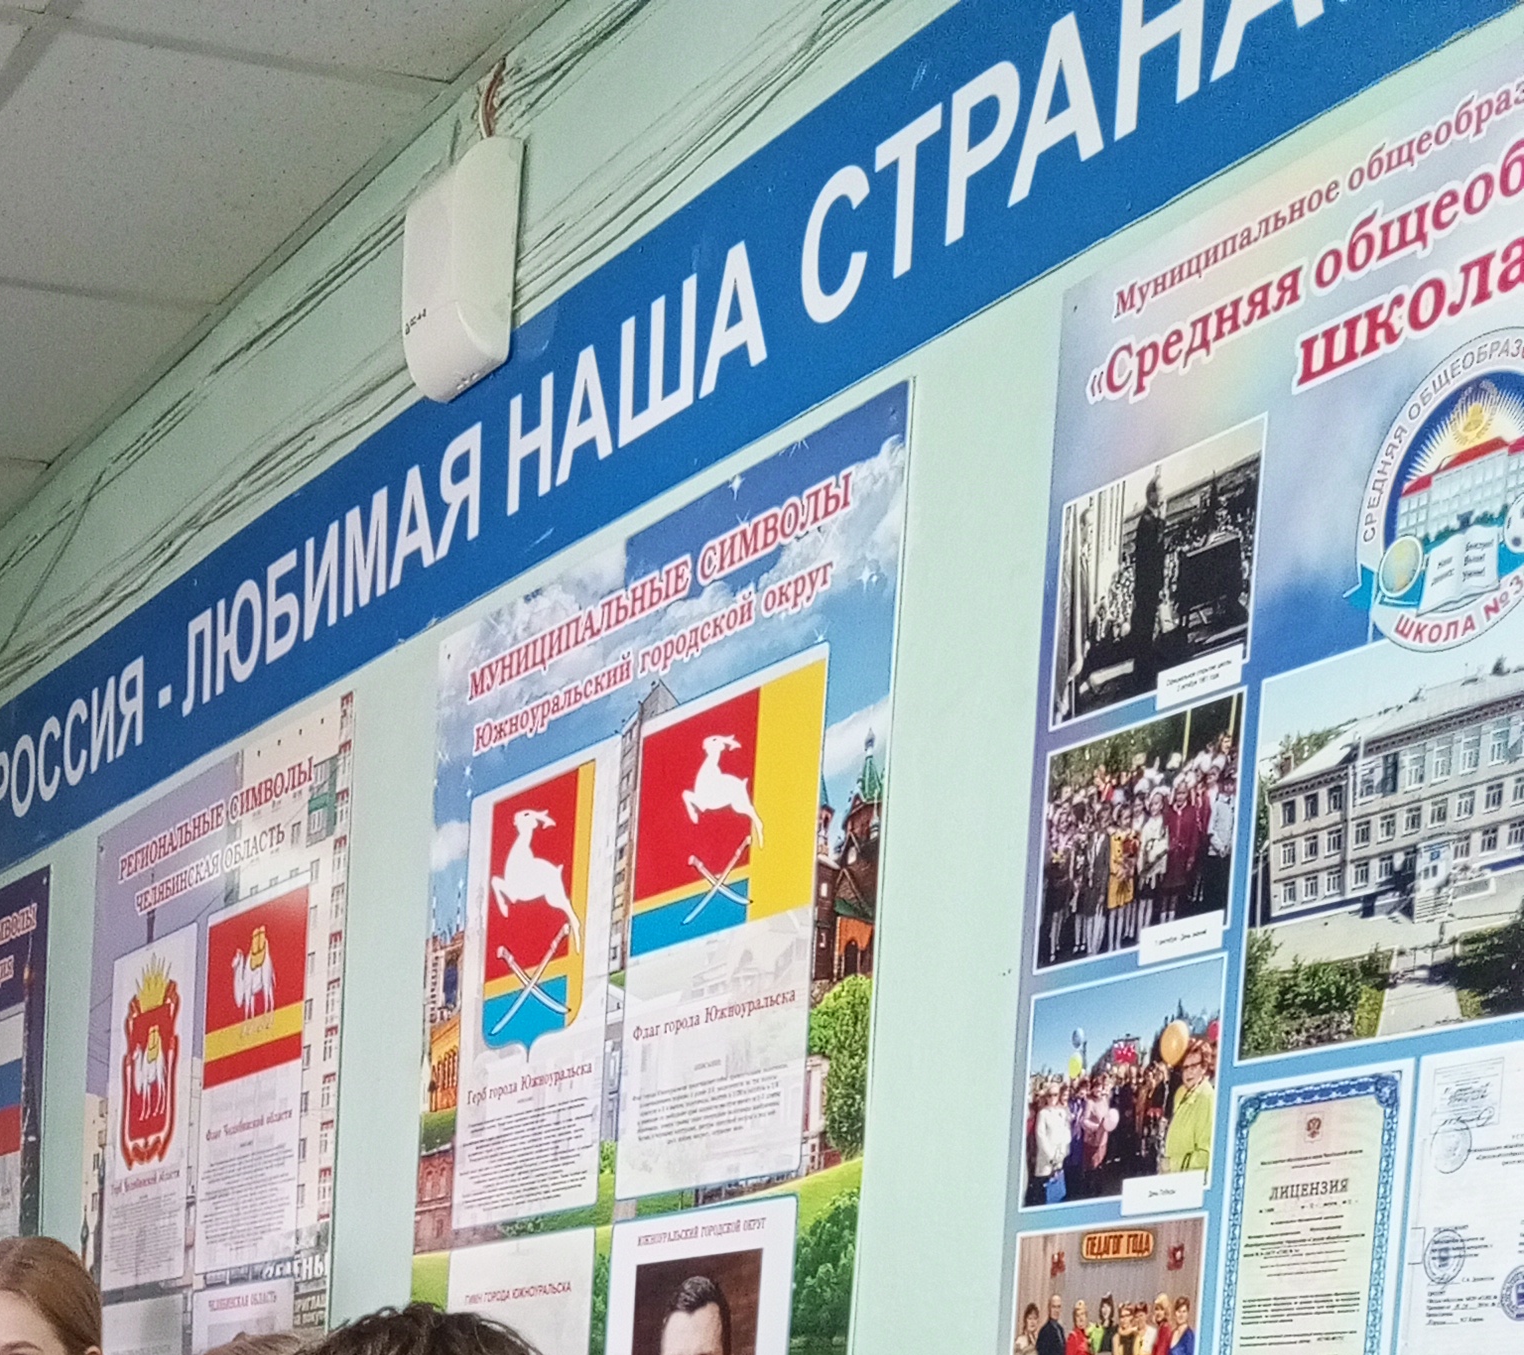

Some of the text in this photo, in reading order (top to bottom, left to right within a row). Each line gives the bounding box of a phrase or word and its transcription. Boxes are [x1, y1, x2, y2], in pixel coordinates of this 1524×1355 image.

[1114, 178, 1341, 319] Муниципальное
[1298, 235, 1524, 387] школа
[1089, 265, 1303, 398] «Средняя
[182, 421, 482, 718] ЛЮБИМАЯ
[507, 240, 767, 516] НАША
[1362, 336, 1524, 543] СРЕДНЯЯ ОБЩЕОБРАЗ
[468, 471, 854, 700] МУНИЦИПАЛЬНЫЕ СИМВОЛЫ
[1393, 612, 1476, 645] ШКОЛА
[474, 560, 834, 754] Южноуральский городской округ
[118, 756, 314, 883] РЕГИОНАЛЬНЫЕ СИМВОЛЫ
[134, 821, 285, 915] ЧЕЛЯБИНСКАЯ ОБЛАСТЬ
[633, 989, 796, 1041] Флаг города Южноуральска
[467, 1086, 487, 1106] Герб
[1126, 1232, 1150, 1257] ГОДА
[1269, 1177, 1349, 1201] ЛИЦЕНЗИЯ
